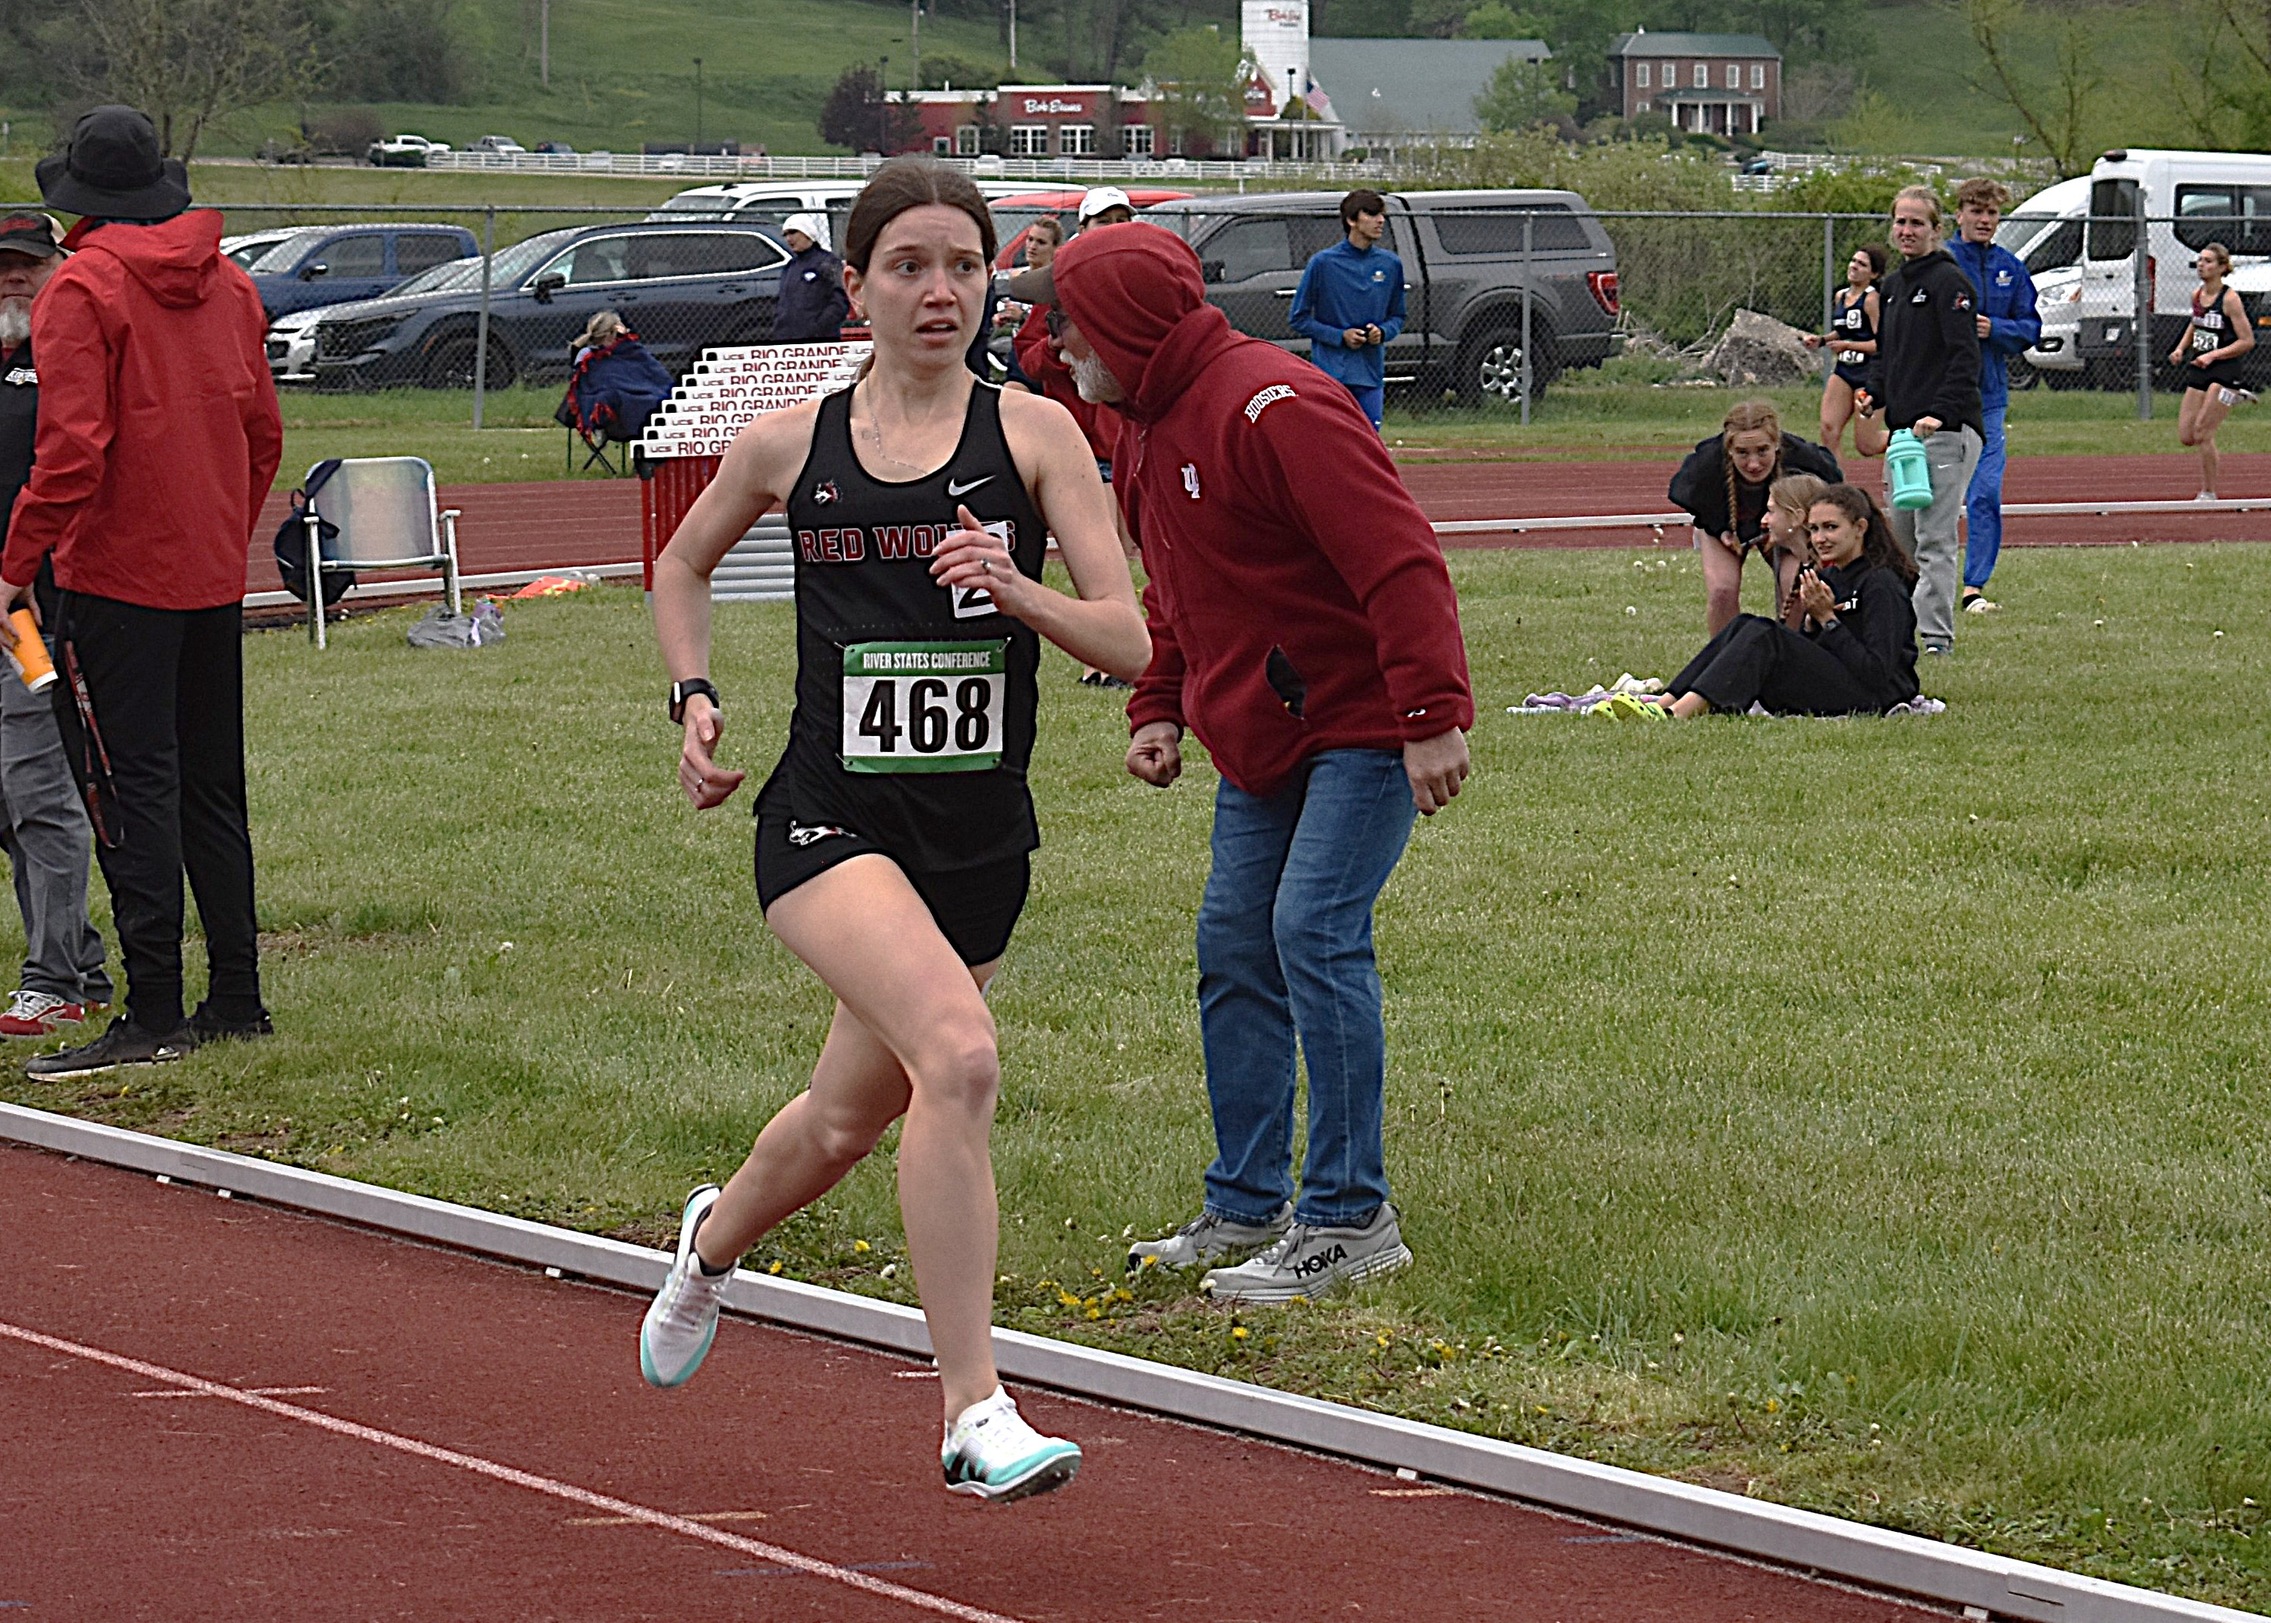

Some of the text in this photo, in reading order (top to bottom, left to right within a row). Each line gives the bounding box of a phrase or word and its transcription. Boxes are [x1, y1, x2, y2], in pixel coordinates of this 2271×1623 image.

[1024, 99, 1083, 113] Bob Evans
[751, 348, 778, 359] RIO
[782, 345, 850, 358] GRANDE
[742, 361, 770, 372] RIO
[774, 358, 842, 371] GRANDE
[730, 374, 758, 385] RIO
[761, 371, 829, 384] GRANDE
[720, 387, 747, 398] RIO
[750, 384, 818, 397] GRANDE
[710, 400, 738, 411] RIO
[1244, 384, 1296, 424] HOOSIERS
[700, 413, 727, 425] RIO
[692, 426, 719, 438] RIO
[678, 441, 705, 455] RIO
[798, 528, 866, 563] RED
[863, 650, 991, 669] RIVER STATES CONFERENCE
[859, 676, 992, 754] 468
[1294, 1243, 1348, 1280] HOKA
